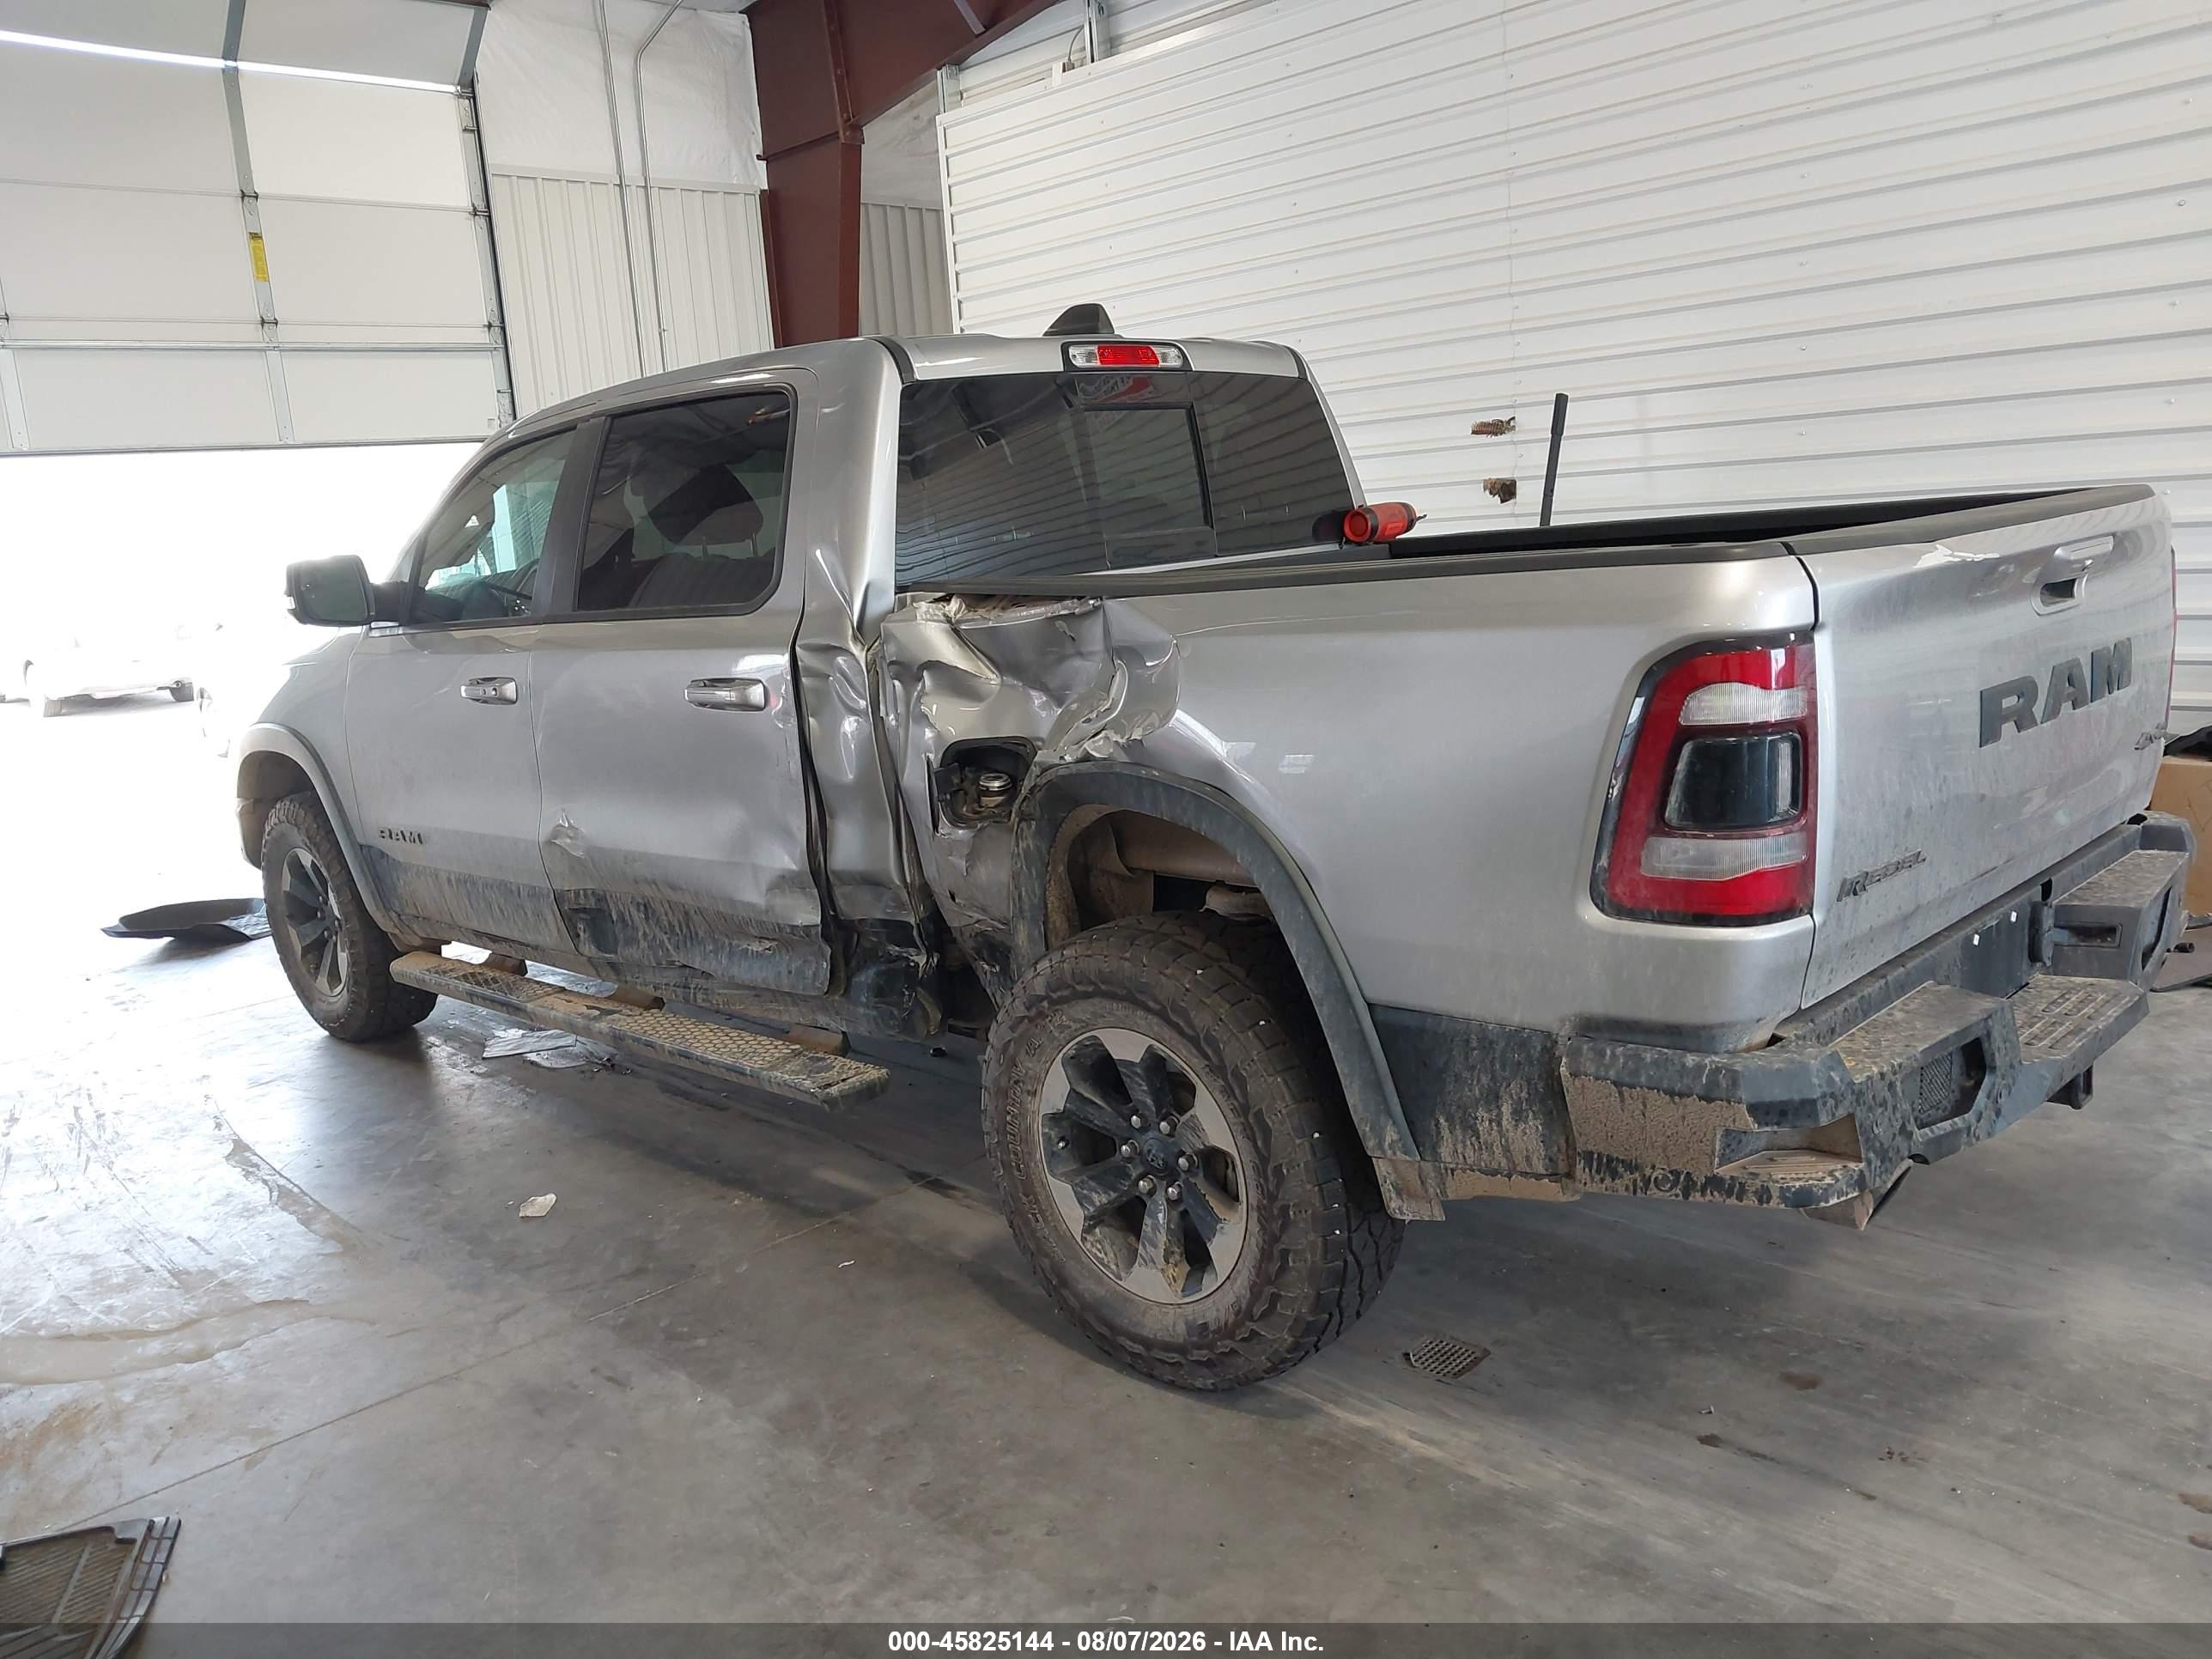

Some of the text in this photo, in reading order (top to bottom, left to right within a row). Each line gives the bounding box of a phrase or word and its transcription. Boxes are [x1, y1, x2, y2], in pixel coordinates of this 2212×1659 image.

[1979, 637, 2133, 749] RAM
[378, 827, 425, 845] RAM
[1837, 848, 1927, 902] REBEL
[1006, 1056, 1027, 1181] COUNTRY
